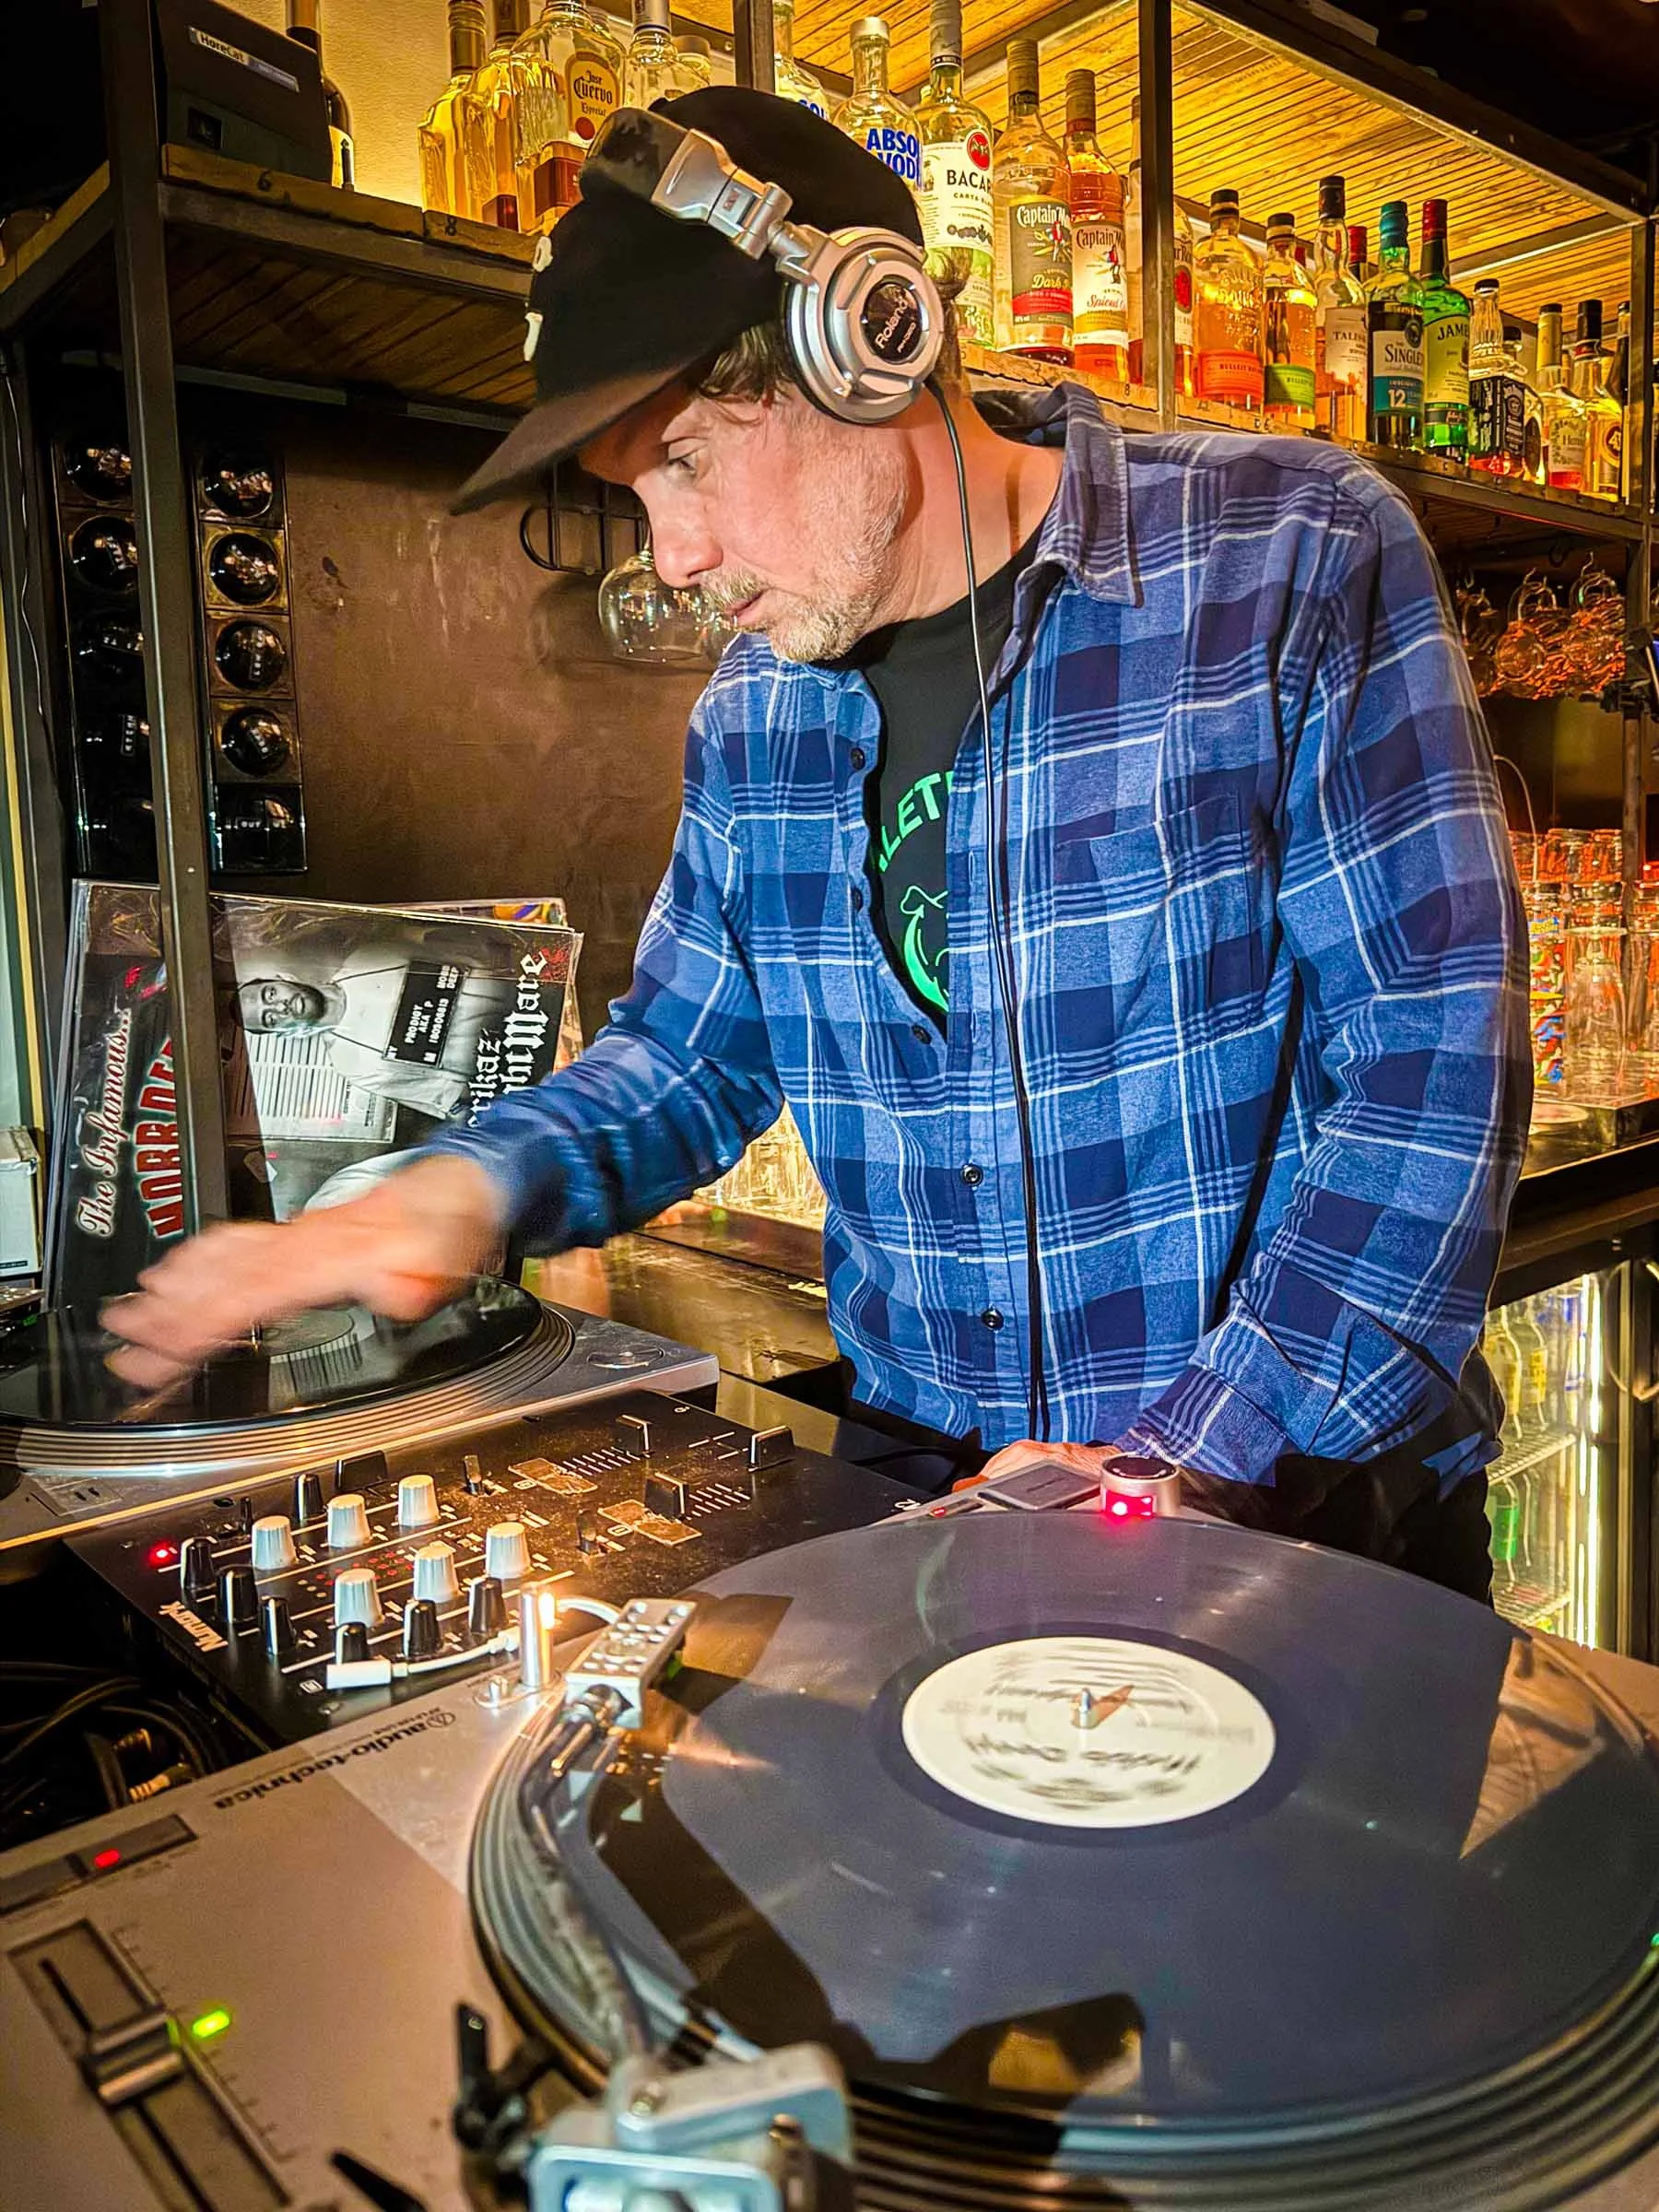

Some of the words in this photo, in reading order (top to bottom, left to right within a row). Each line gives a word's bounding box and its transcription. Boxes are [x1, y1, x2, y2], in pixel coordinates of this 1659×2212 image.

[573, 76, 613, 105] Cuervo
[866, 128, 920, 157] ABSO
[877, 152, 920, 182] VOD
[1017, 205, 1057, 228] Captain
[1077, 229, 1110, 249] Captain
[875, 294, 908, 349] Roland
[1388, 389, 1406, 407] 12
[1608, 434, 1621, 451] 4
[424, 1000, 434, 1008] P
[405, 1004, 423, 1043] PRODIGY
[418, 1015, 431, 1033] AKA
[76, 1182, 116, 1238] The
[159, 1600, 229, 1653] Numark
[213, 1723, 429, 1810] audio-technica
